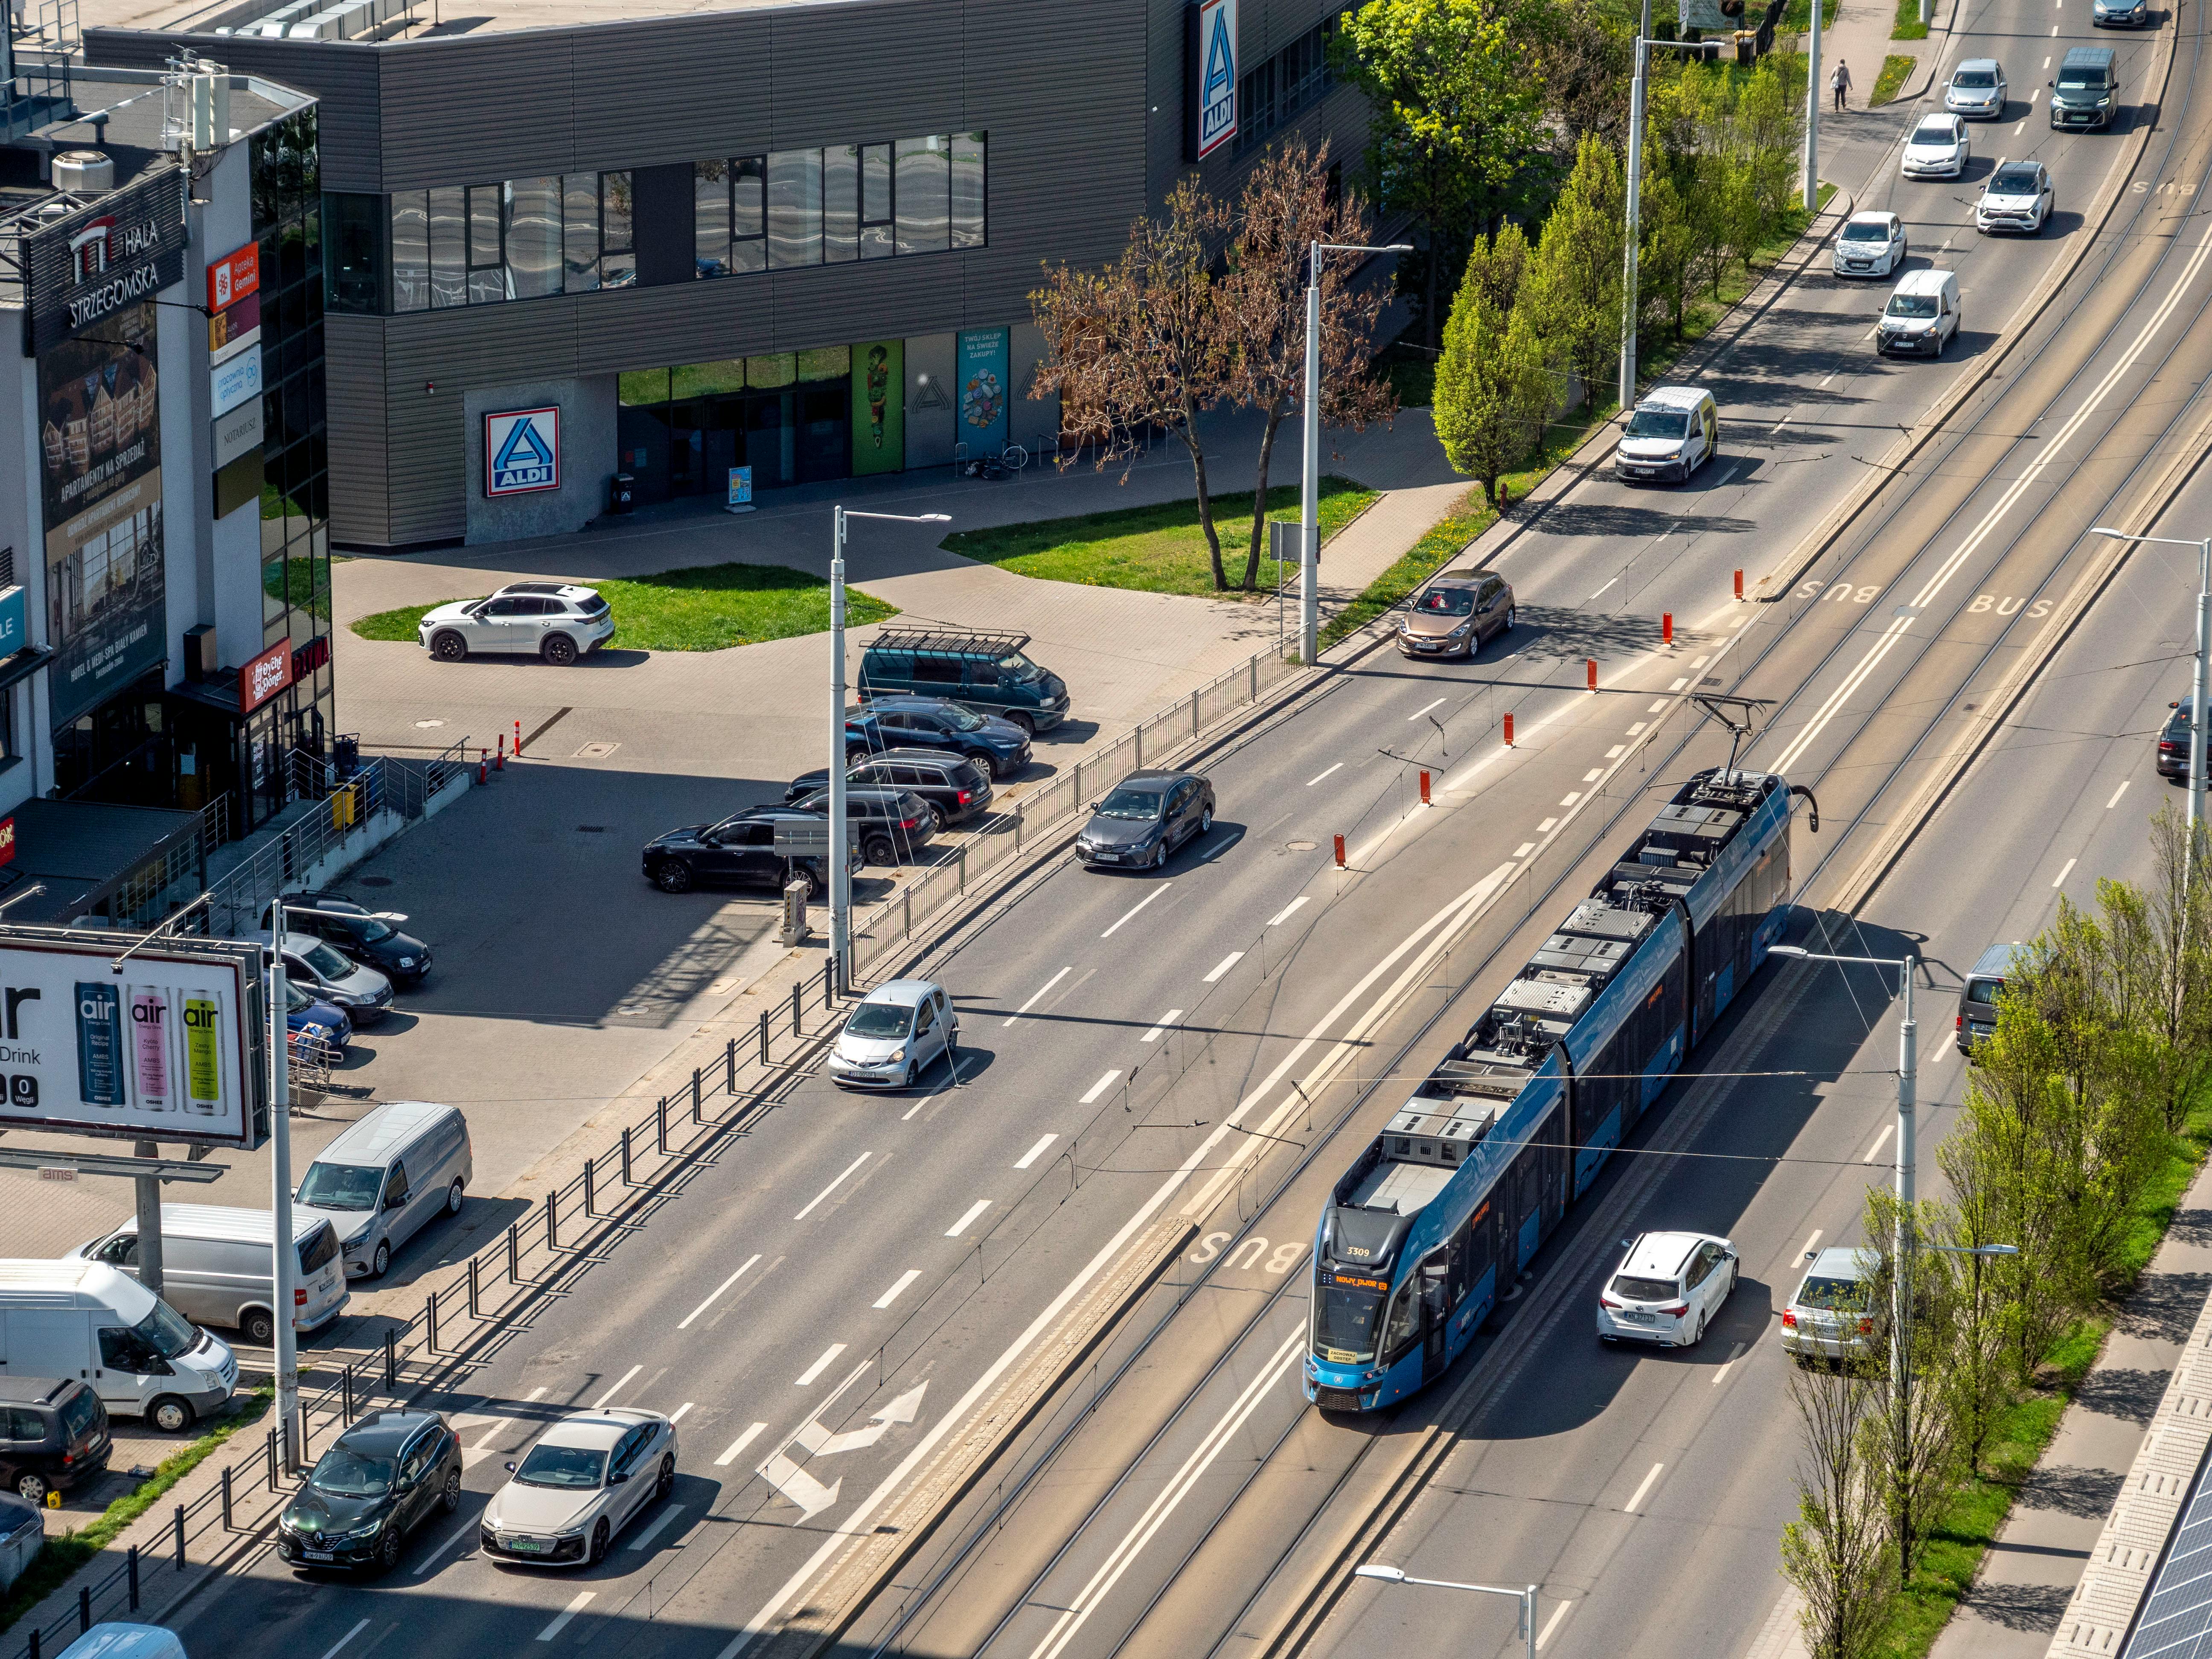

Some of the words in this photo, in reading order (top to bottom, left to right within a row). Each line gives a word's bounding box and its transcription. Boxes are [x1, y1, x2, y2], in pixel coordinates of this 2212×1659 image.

[1205, 96, 1231, 137] ALDI
[2133, 181, 2196, 196] BUS
[125, 220, 157, 256] HALA
[235, 256, 254, 276] Apteka
[235, 269, 256, 291] Gemini
[70, 263, 158, 328] STRZEGOMSKA
[969, 350, 995, 358] ZAKUPY!
[218, 367, 244, 392] pracownia
[220, 380, 243, 402] optyczna
[224, 417, 256, 446] NOTARIUSZ
[61, 464, 104, 503] APARTAMENTY
[106, 459, 114, 477] NA
[115, 437, 145, 471] SPRZEDAŻ
[500, 468, 547, 486] ALDI
[88, 498, 116, 525] APARTAMENT
[116, 484, 140, 507] WZORCOWY
[1796, 581, 1882, 604] BUS
[1966, 594, 2054, 618] BUS
[71, 662, 85, 683] HOTEL
[87, 660, 90, 672] &
[92, 644, 114, 669] MEDI-SPA
[115, 634, 129, 653] BIAŁY
[129, 619, 147, 644] KAMIEŃ
[80, 994, 115, 1020] air
[132, 998, 166, 1023] air
[183, 1003, 218, 1027] air
[0, 1046, 41, 1065] Drink
[18, 1079, 29, 1094] 0
[15, 1095, 34, 1104] Węgli
[43, 1169, 73, 1180] ams
[1190, 1231, 1308, 1274] BUS
[1347, 1247, 1370, 1257] 3309
[1336, 1275, 1355, 1285] NOWY
